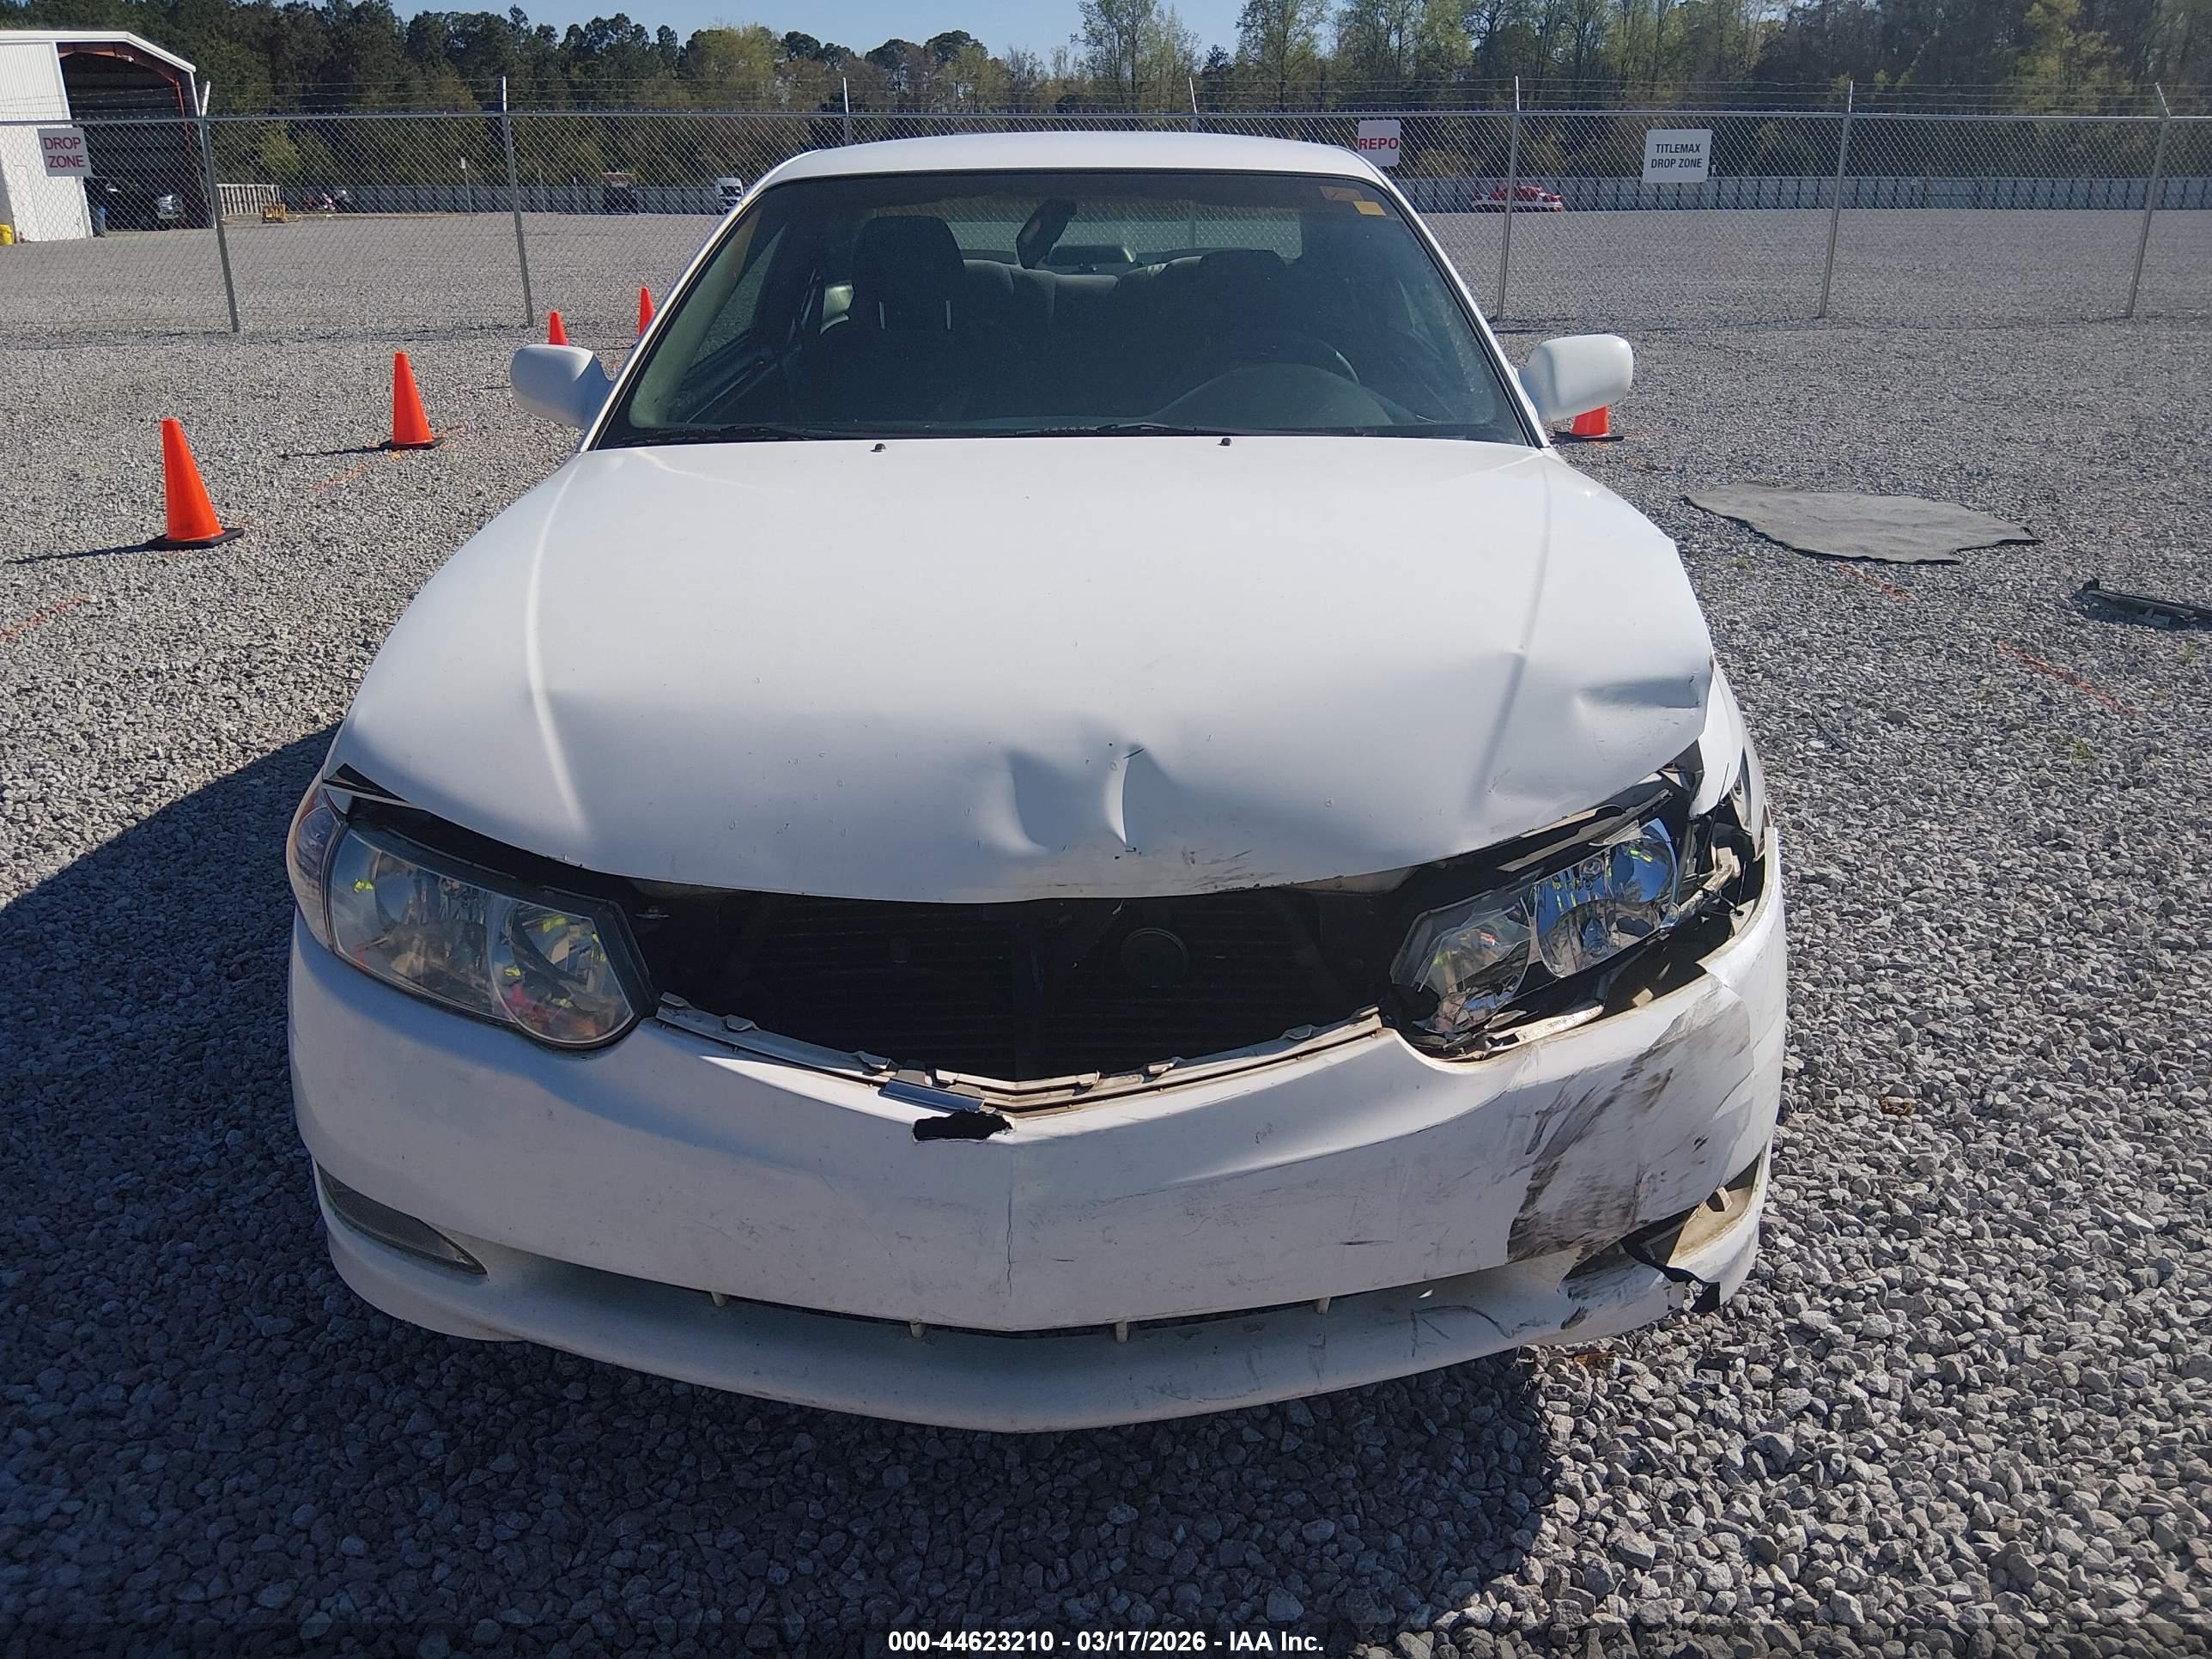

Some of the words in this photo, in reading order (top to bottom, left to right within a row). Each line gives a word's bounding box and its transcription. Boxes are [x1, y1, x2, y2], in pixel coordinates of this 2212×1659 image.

[43, 137, 82, 149] DROP
[1358, 137, 1400, 150] REPO
[1656, 143, 1701, 154] TITLEMAX
[47, 155, 85, 168] ZONE
[1650, 158, 1676, 168] DROP
[1678, 158, 1703, 168] ZONE
